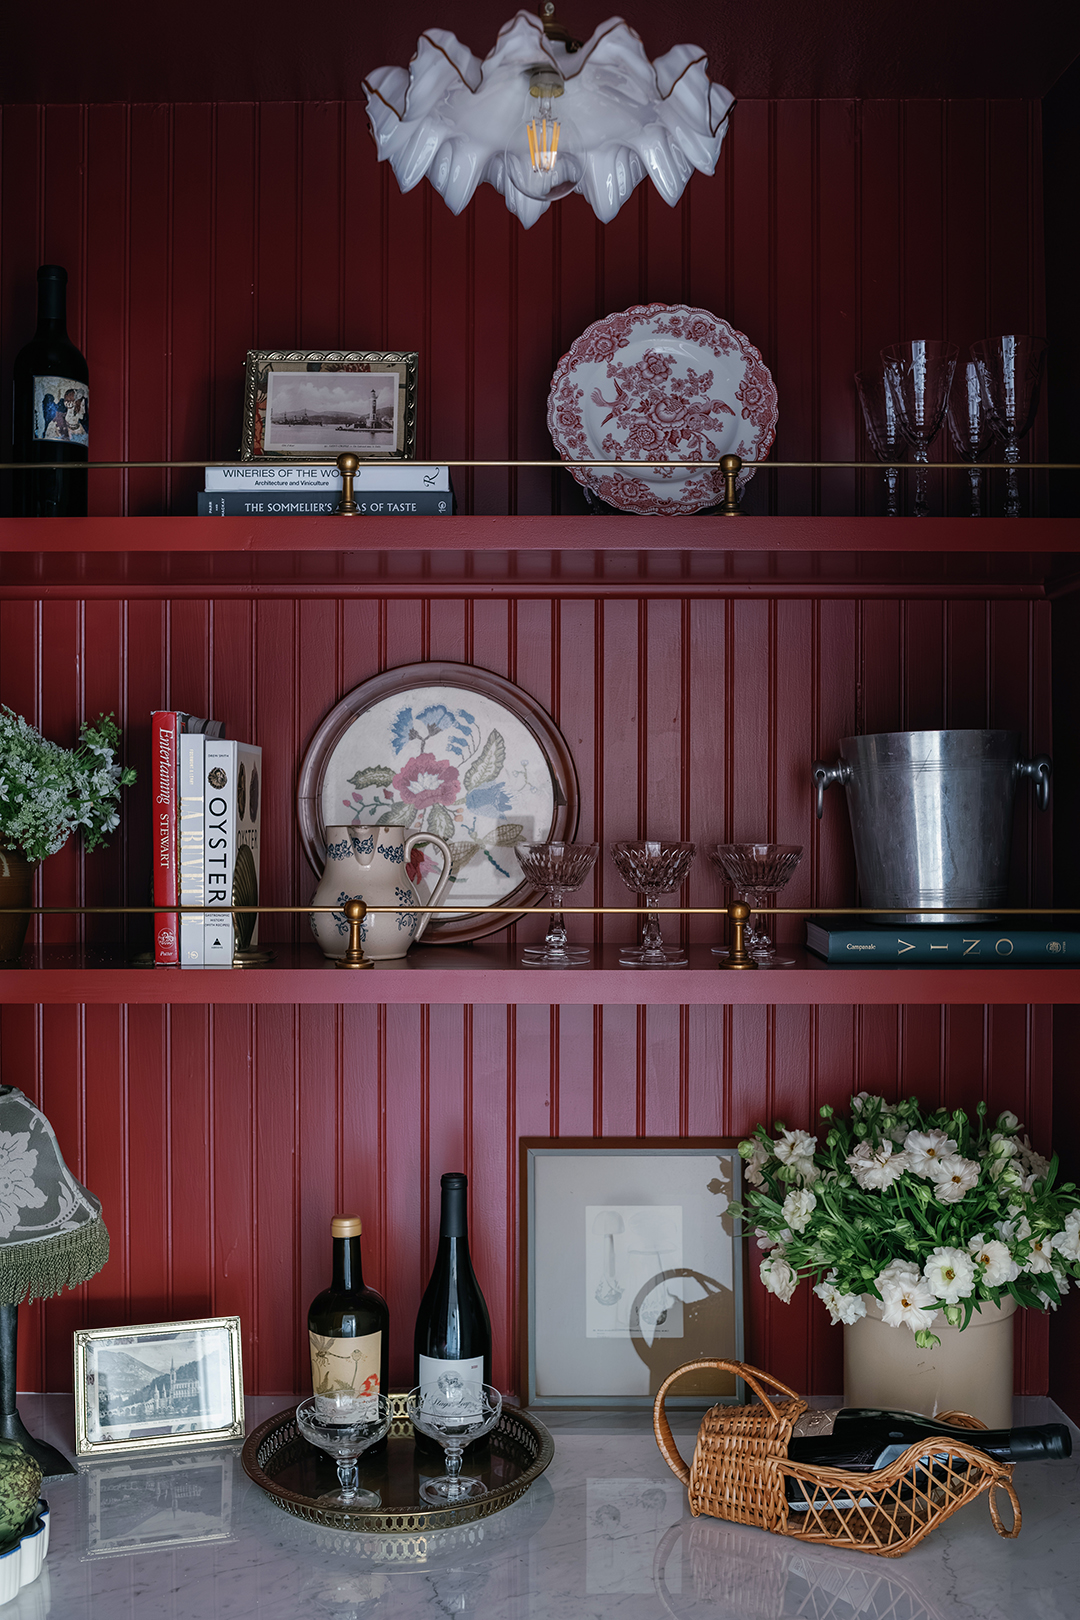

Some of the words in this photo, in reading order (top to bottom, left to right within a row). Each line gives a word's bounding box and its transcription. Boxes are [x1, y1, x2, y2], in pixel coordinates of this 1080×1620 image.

[222, 469, 276, 478] WINERIES
[277, 469, 293, 478] OF
[296, 469, 318, 478] THE
[320, 469, 361, 478] WOD
[244, 503, 264, 512] THE
[267, 502, 332, 512] SOMMELIER'S
[370, 503, 384, 512] OF
[386, 503, 417, 512] TASTE
[156, 727, 175, 805] Entertaining
[160, 813, 170, 869] STEWART
[208, 797, 228, 904] OYSTER
